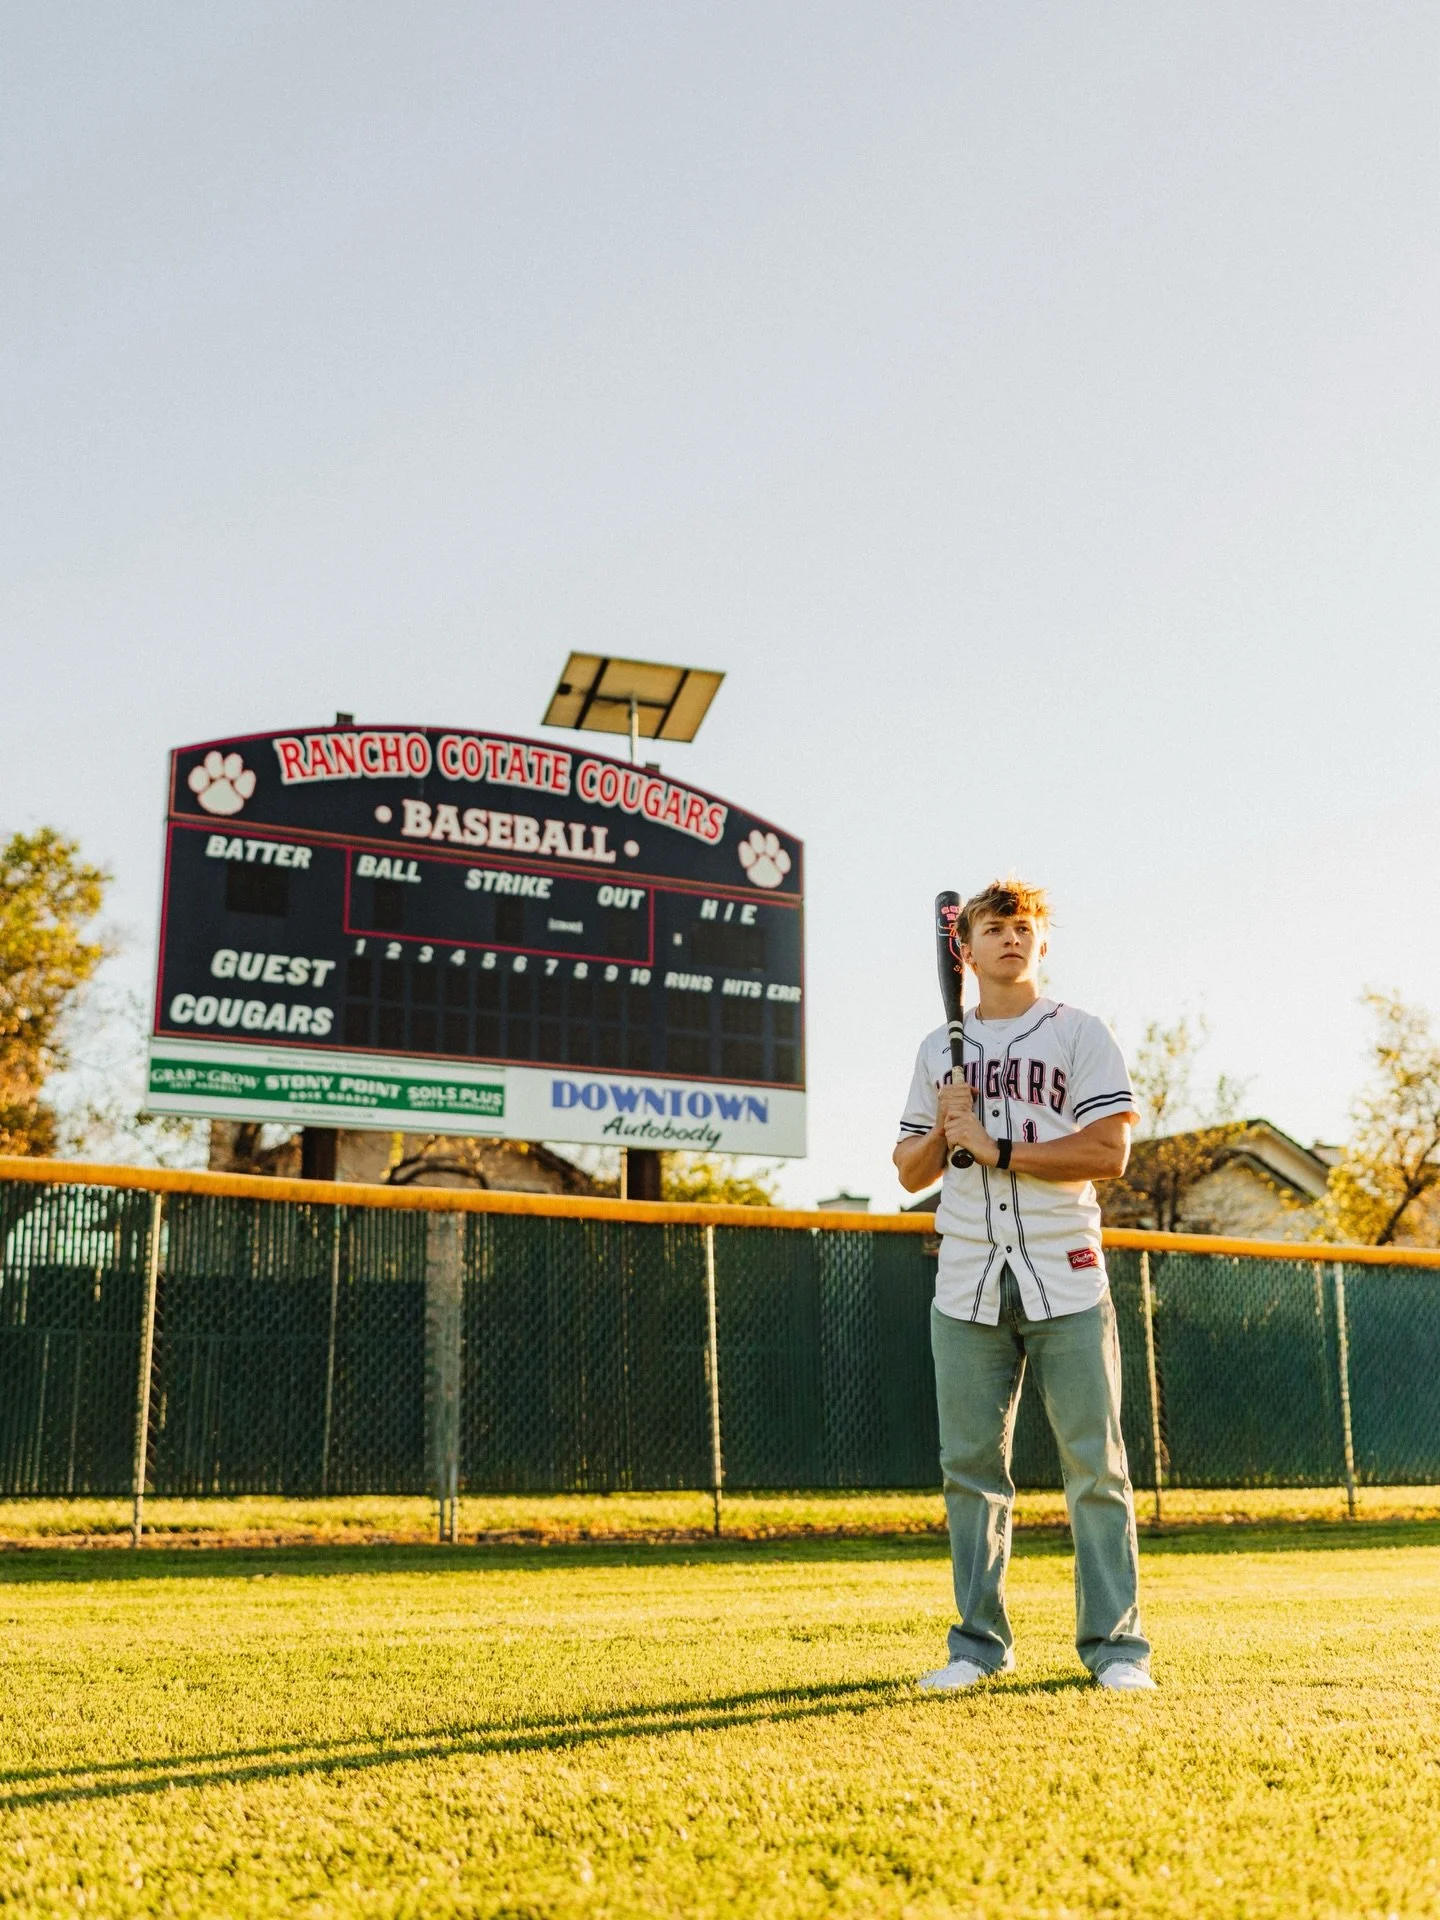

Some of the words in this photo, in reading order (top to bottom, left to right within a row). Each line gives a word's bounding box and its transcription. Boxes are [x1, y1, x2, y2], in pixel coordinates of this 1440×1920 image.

[273, 732, 432, 786] RANCHO
[437, 734, 572, 796] COTATE
[576, 759, 728, 845] COUGARS
[401, 799, 616, 863] BASEBALL
[205, 835, 312, 869] BATTER
[356, 854, 422, 883] BALL
[464, 868, 554, 899] STRIKE
[597, 885, 646, 909] OUT
[211, 949, 336, 987] GUEST
[355, 938, 366, 955] 1
[386, 942, 402, 959] 2
[419, 945, 434, 963] 3
[450, 949, 466, 966] 4
[482, 952, 497, 969] 5
[513, 955, 528, 973] 6
[545, 958, 559, 976] 7
[574, 962, 588, 979] 8
[605, 964, 619, 982] 9
[630, 967, 651, 985] 10
[664, 971, 714, 992] RUNS
[722, 978, 763, 998] HITS
[766, 983, 802, 1003] ERR
[169, 993, 334, 1036] COUGARS
[151, 1068, 197, 1084] GRAB
[207, 1069, 261, 1090] GROW
[264, 1074, 334, 1091] STONY
[339, 1077, 402, 1099] POINT
[407, 1086, 458, 1101] SOILS
[459, 1088, 504, 1106] PLUS
[551, 1080, 769, 1124] DOWNTOWN
[602, 1115, 723, 1150] Autobody
